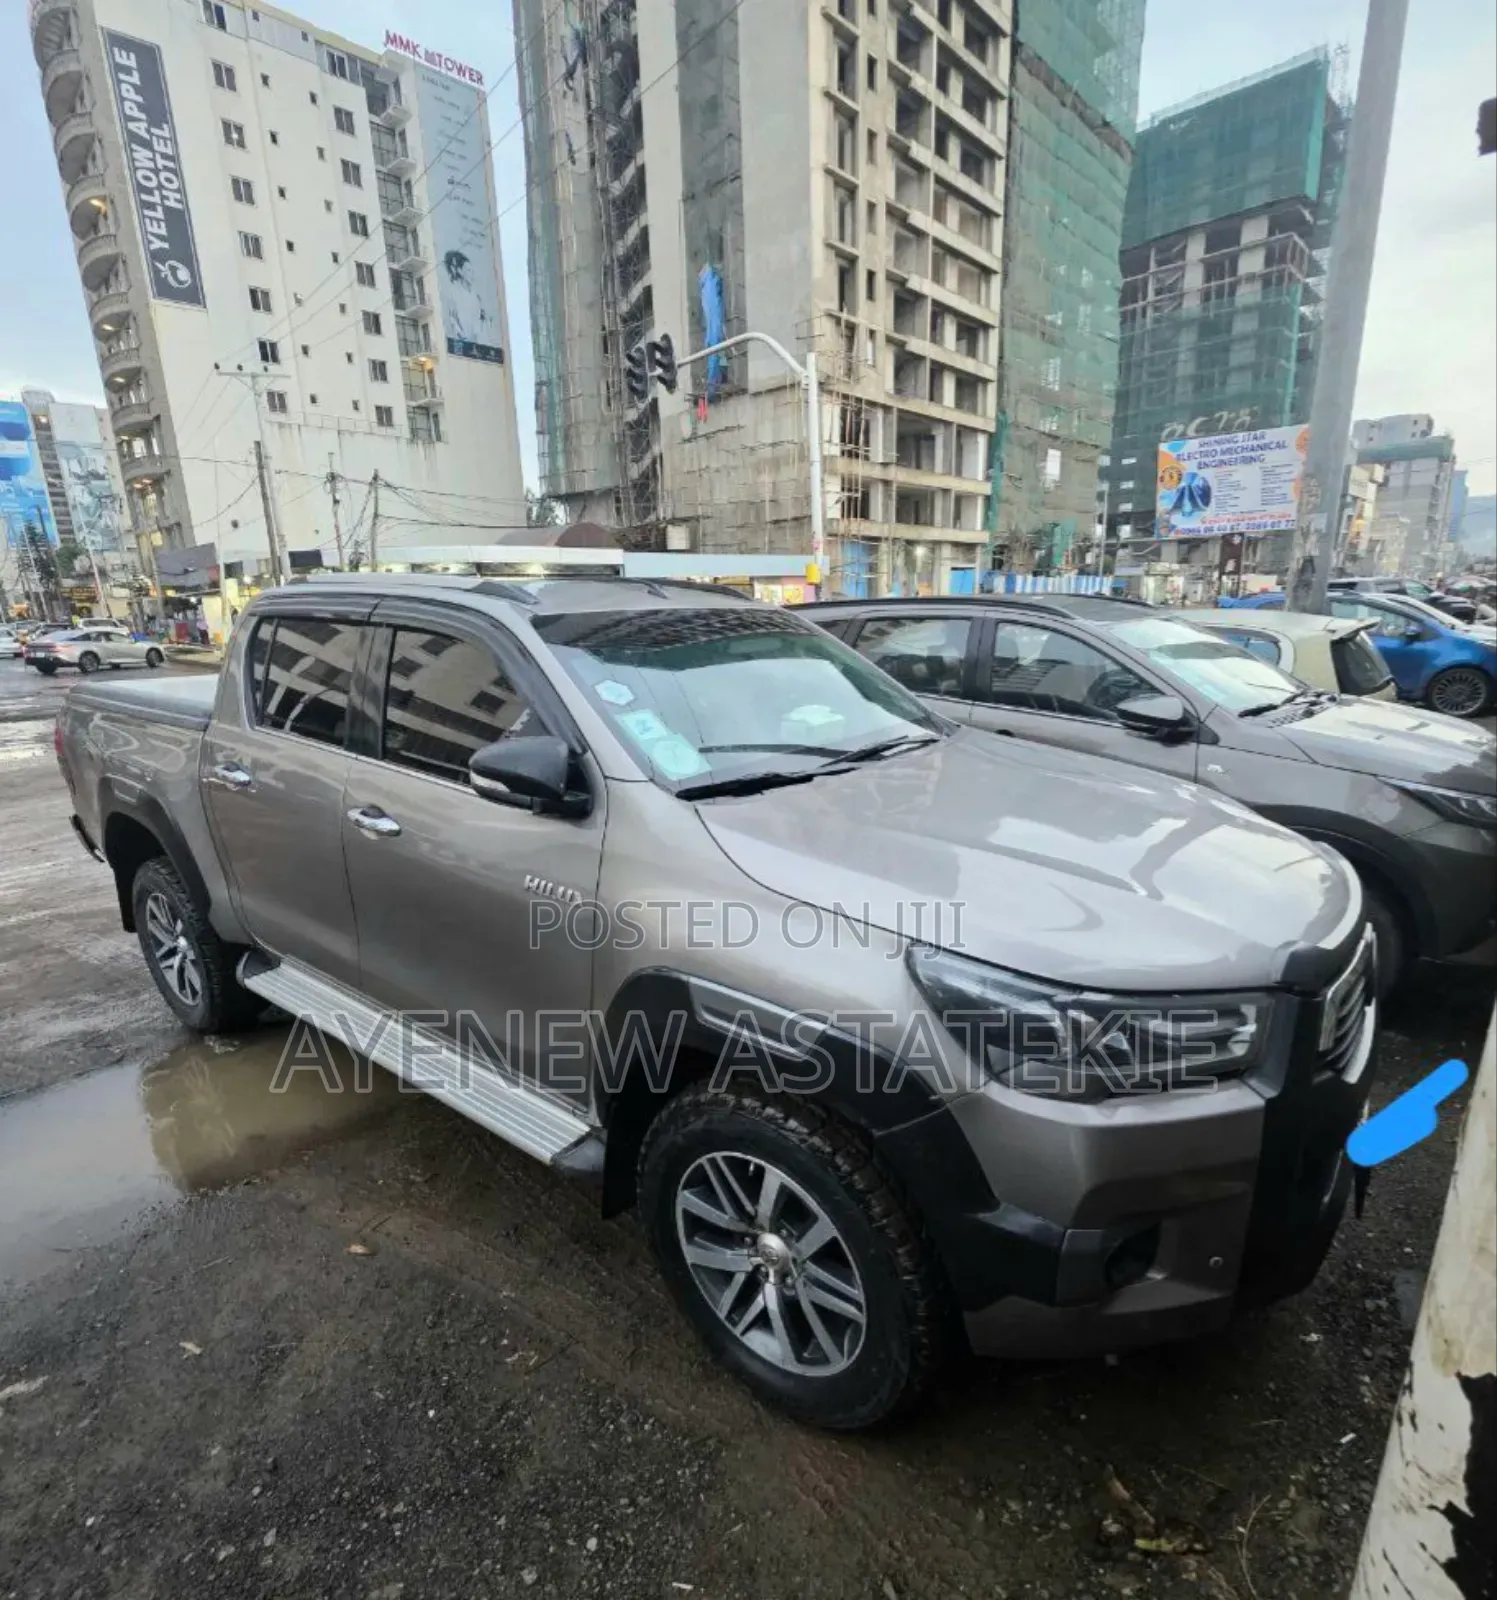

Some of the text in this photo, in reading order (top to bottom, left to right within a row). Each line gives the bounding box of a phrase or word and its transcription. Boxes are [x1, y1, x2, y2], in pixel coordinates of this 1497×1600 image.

[384, 29, 422, 59] MMK
[436, 53, 484, 86] TOWER
[113, 47, 170, 250] YELLOW APPLE
[151, 123, 184, 209] HOTEL
[1176, 440, 1288, 461] ELECTRO MECHANICAL
[1197, 453, 1265, 470] ENGINEERING
